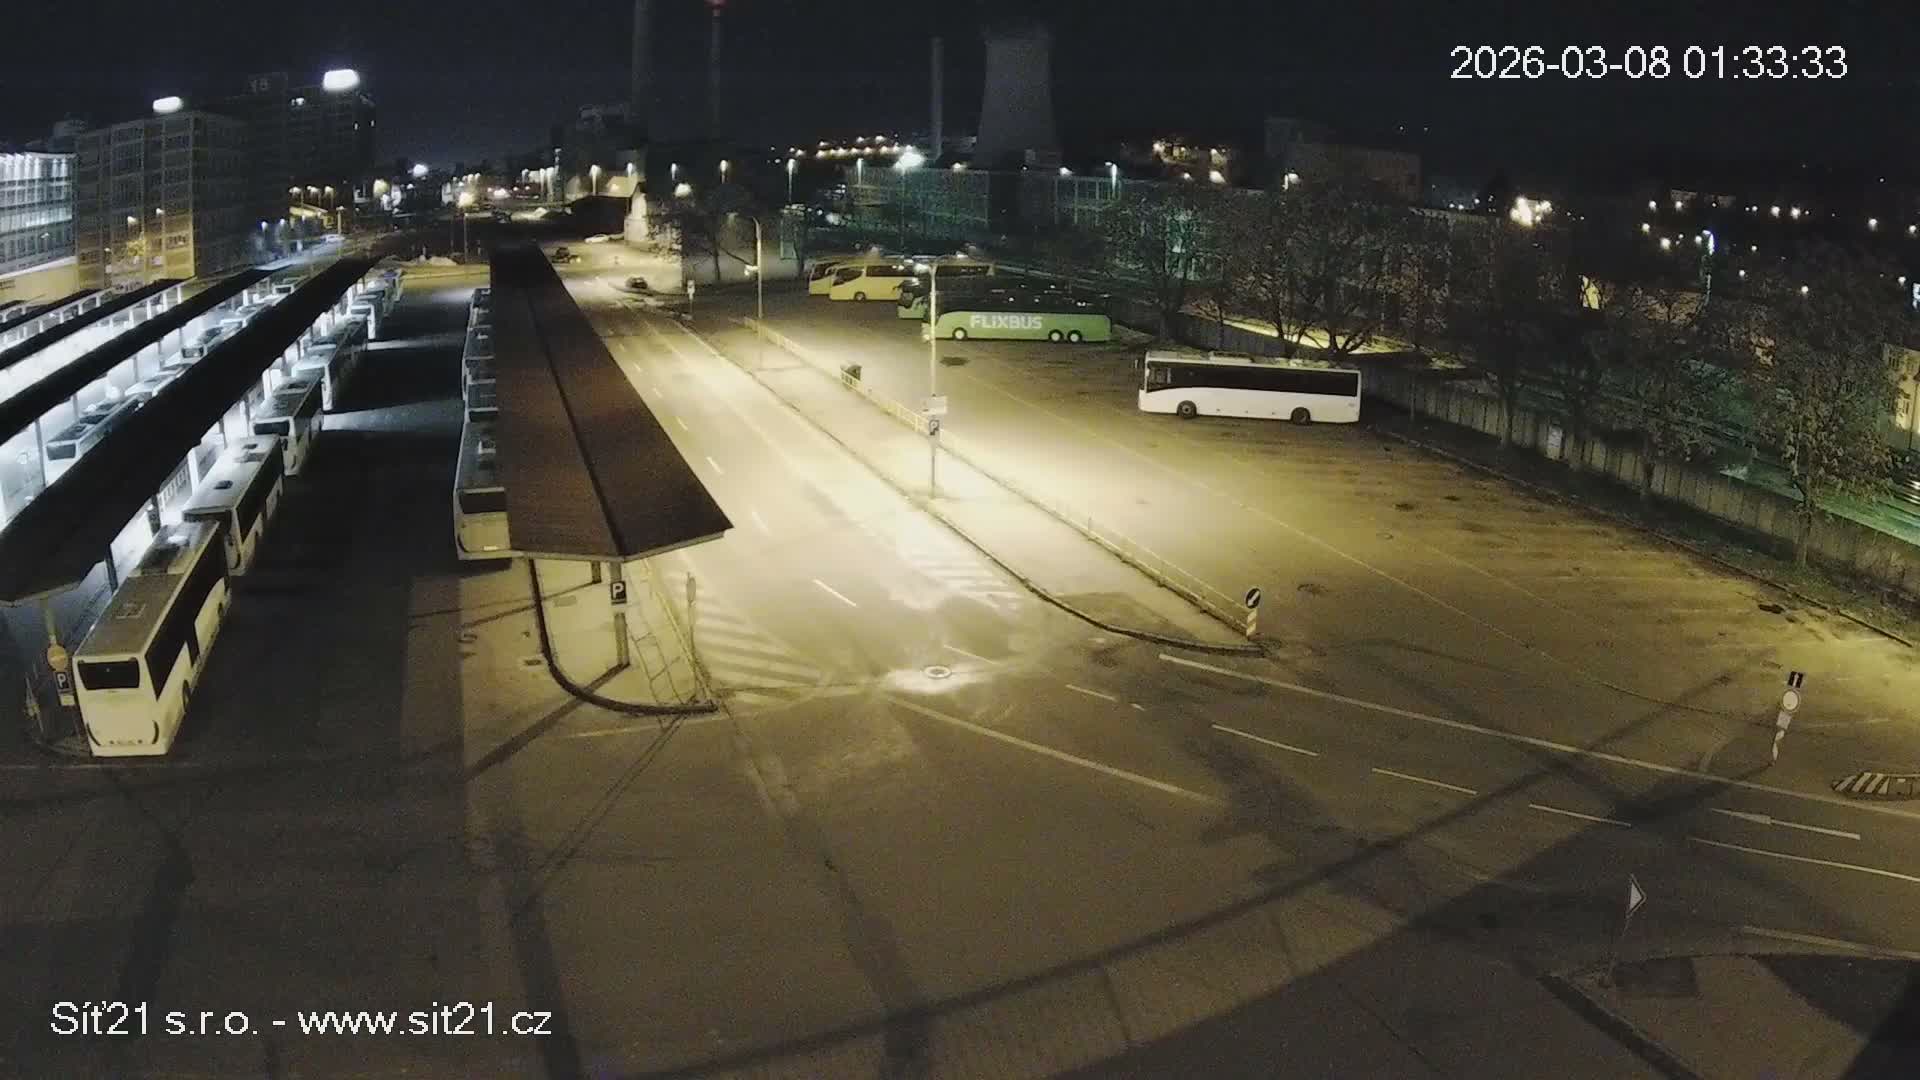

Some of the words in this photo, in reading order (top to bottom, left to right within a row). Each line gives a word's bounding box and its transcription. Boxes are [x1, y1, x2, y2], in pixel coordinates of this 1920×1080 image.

[969, 314, 1043, 330] FLIXBUS
[612, 582, 624, 599] P
[56, 673, 67, 688] P
